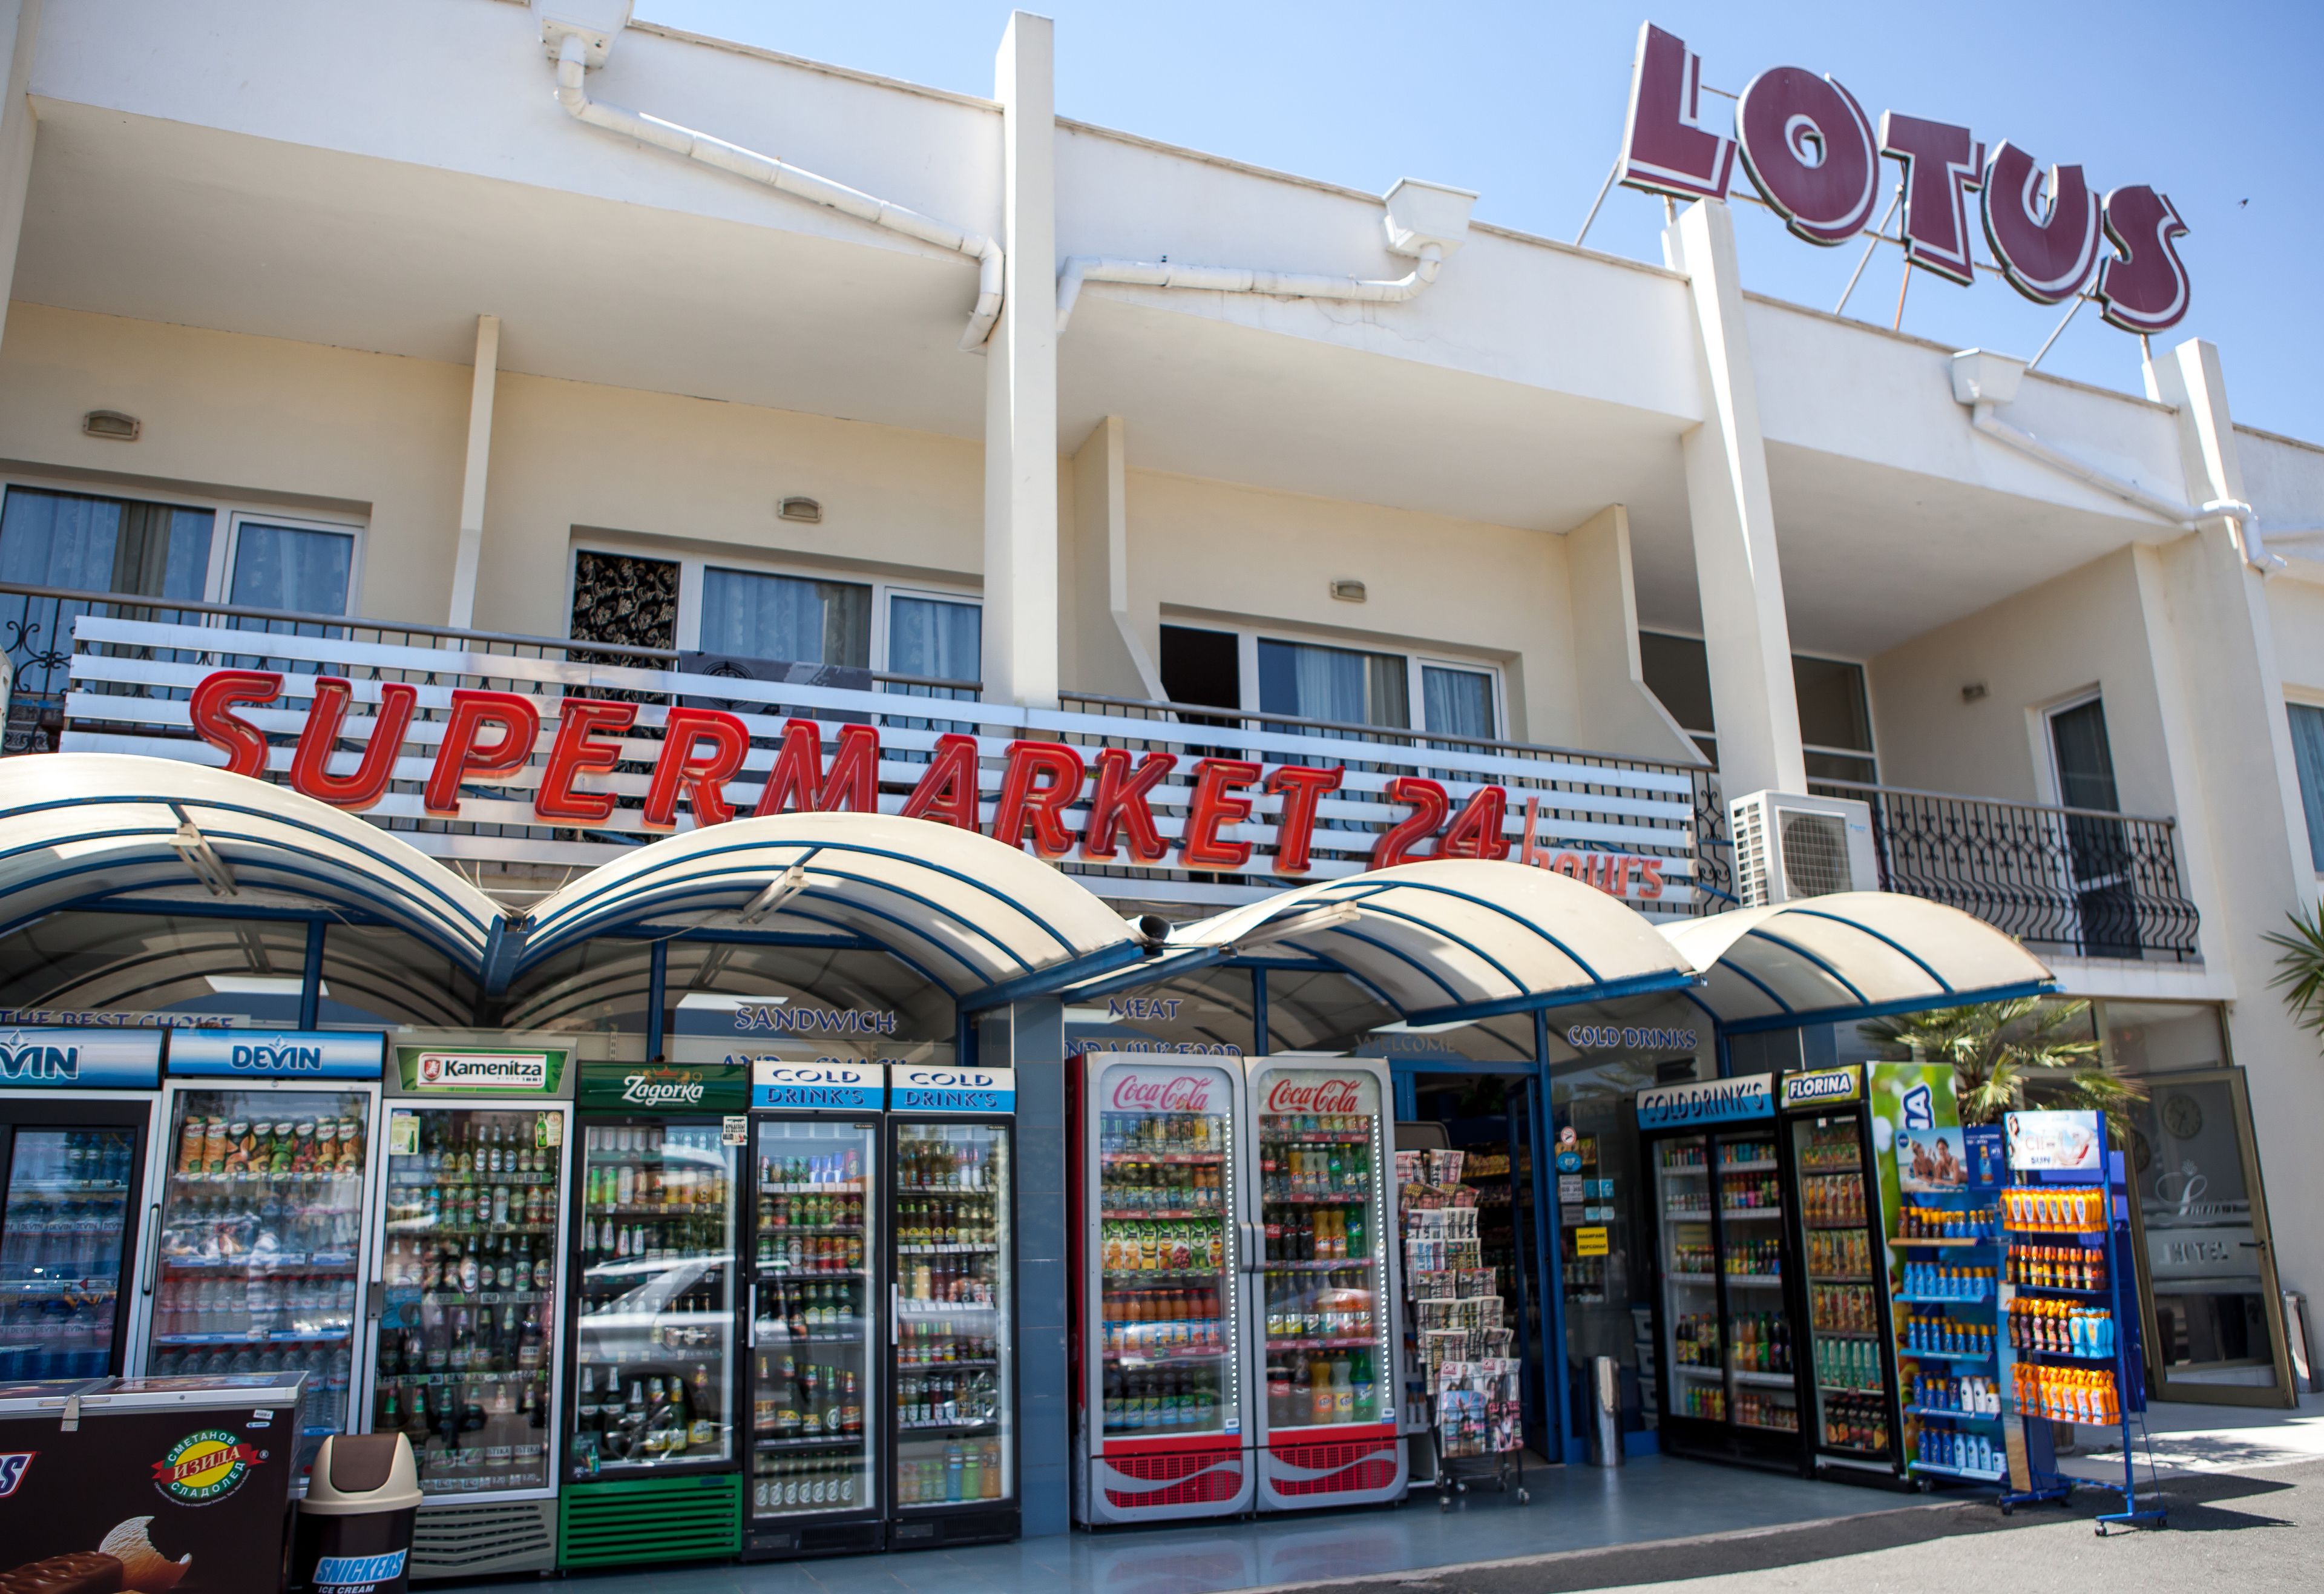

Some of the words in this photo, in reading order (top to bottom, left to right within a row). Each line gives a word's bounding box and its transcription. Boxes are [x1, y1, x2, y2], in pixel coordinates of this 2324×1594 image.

[1618, 20, 2190, 334] LOTUS
[190, 670, 1345, 875] SUPERMARKET
[1367, 776, 1511, 872] 24
[734, 1005, 898, 1034] SANDWICH
[1108, 997, 1183, 1021] MEAT
[1569, 1025, 1620, 1049] COLD
[1624, 1027, 1697, 1051] DRINKS
[231, 1044, 322, 1070] DEVIN
[444, 1059, 542, 1077] Kamenitza
[772, 1068, 861, 1083] COLD
[910, 1072, 994, 1087] COLD
[1788, 1072, 1854, 1101] FLORINA
[622, 1075, 704, 1107] Zagorka
[766, 1087, 865, 1105] DRINK'S
[904, 1090, 999, 1108] DRINK'S
[1113, 1075, 1215, 1112] Coca-Cola
[1268, 1078, 1362, 1113] Coca-Cola
[1643, 1092, 1689, 1123] COLD
[168, 1431, 235, 1461] СМЕТАНОВ
[173, 1446, 241, 1480] ИЗИДА
[171, 1463, 246, 1498] СЛАДОЛЕД
[315, 1551, 405, 1582] SNICKERS
[337, 1584, 375, 1594] CREAM
